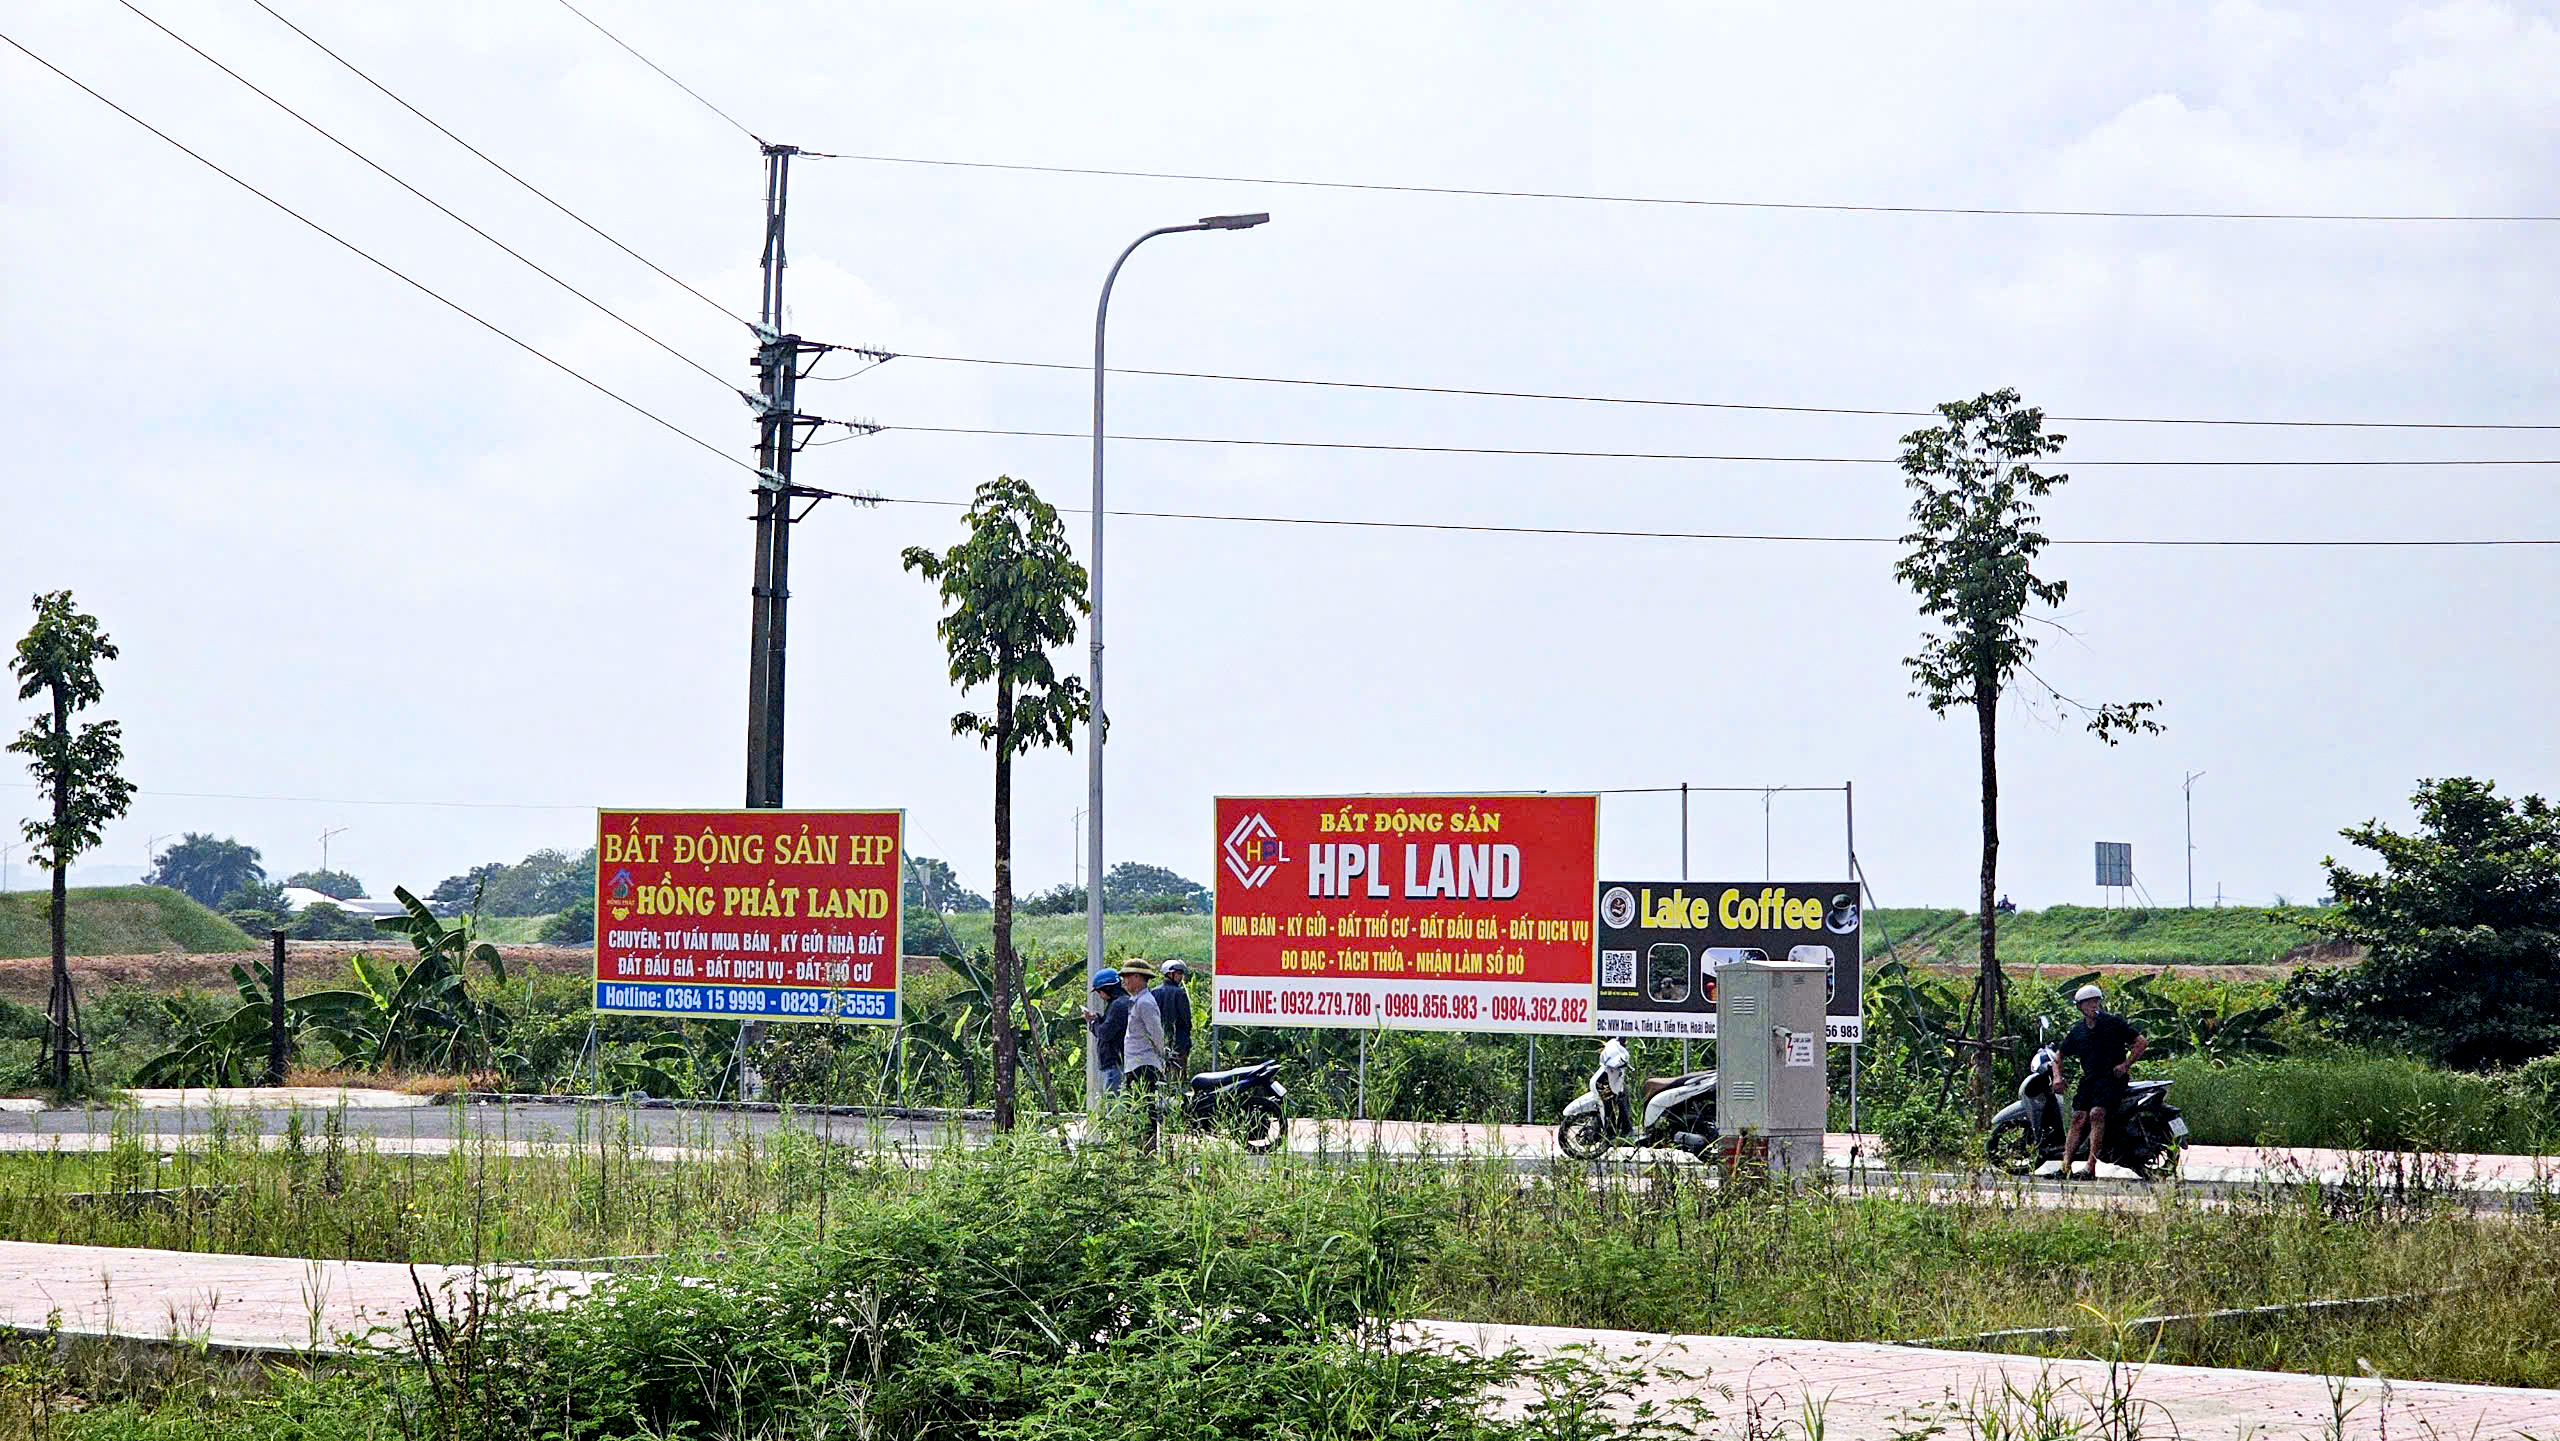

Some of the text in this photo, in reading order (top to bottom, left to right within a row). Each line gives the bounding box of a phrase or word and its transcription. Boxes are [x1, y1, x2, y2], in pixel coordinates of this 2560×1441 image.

[1320, 804, 1501, 838] BẤT ĐỘNG SẢN
[604, 817, 894, 873] BẤT ĐỘNG SẢN HP
[1246, 840, 1291, 862] HPL
[1308, 843, 1521, 900] HPL LAND
[636, 871, 889, 919] HỒNG PHÁT LAND
[1640, 887, 1824, 931] Lake Coffee
[608, 927, 661, 949] CHUYÊN:
[664, 930, 681, 950] TƯ
[682, 926, 708, 950] VẤN
[711, 933, 740, 951] MUA
[781, 930, 798, 953] KÝ
[801, 928, 824, 953] GỬI
[827, 931, 855, 954] NHÀ
[858, 929, 885, 955] ĐẤT
[1221, 915, 1248, 936] MUA
[1250, 912, 1276, 936] BÁN
[1287, 913, 1303, 937] KÝ
[1305, 910, 1327, 937] GỬI
[1338, 911, 1362, 938] ĐẤT
[1364, 909, 1389, 938] THỔ
[1391, 915, 1410, 938] CƯ
[1419, 911, 1444, 939] ĐẤT
[1447, 911, 1473, 940] ĐẤU
[1476, 914, 1498, 940] GIÁ
[1509, 912, 1535, 941] ĐẤT
[1537, 919, 1569, 945] DỊCH
[1571, 919, 1589, 946] VỤ
[618, 951, 642, 975] ĐẤT
[644, 952, 670, 976] ĐẤU
[673, 955, 695, 977] GIÁ
[706, 953, 731, 978] ĐẤT
[733, 959, 764, 983] DỊCH
[767, 961, 784, 984] VỤ
[796, 956, 821, 981] ĐẤT
[853, 962, 874, 983] CƯ
[1281, 950, 1298, 970] ĐO
[1301, 950, 1326, 975] ĐẠC
[1337, 947, 1369, 971] TÁCH
[1372, 945, 1405, 972] THỬA
[1416, 948, 1452, 977] NHẬN
[1455, 949, 1483, 974] LÀM
[1486, 945, 1505, 974] SỔ
[1506, 947, 1525, 975] ĐỎ
[605, 985, 661, 1008] Hotline:
[665, 988, 702, 1010] 0364
[706, 989, 725, 1010] 15
[728, 990, 766, 1012] 9999
[780, 992, 819, 1013] 0829
[846, 994, 886, 1016] 5555
[1219, 989, 1277, 1014] HOTLINE:
[1281, 991, 1371, 1016] 0932.279.780
[1385, 993, 1478, 1019] 0989.856.983
[1492, 996, 1588, 1023] 0984.362.882
[1840, 1025, 1859, 1038] 983
